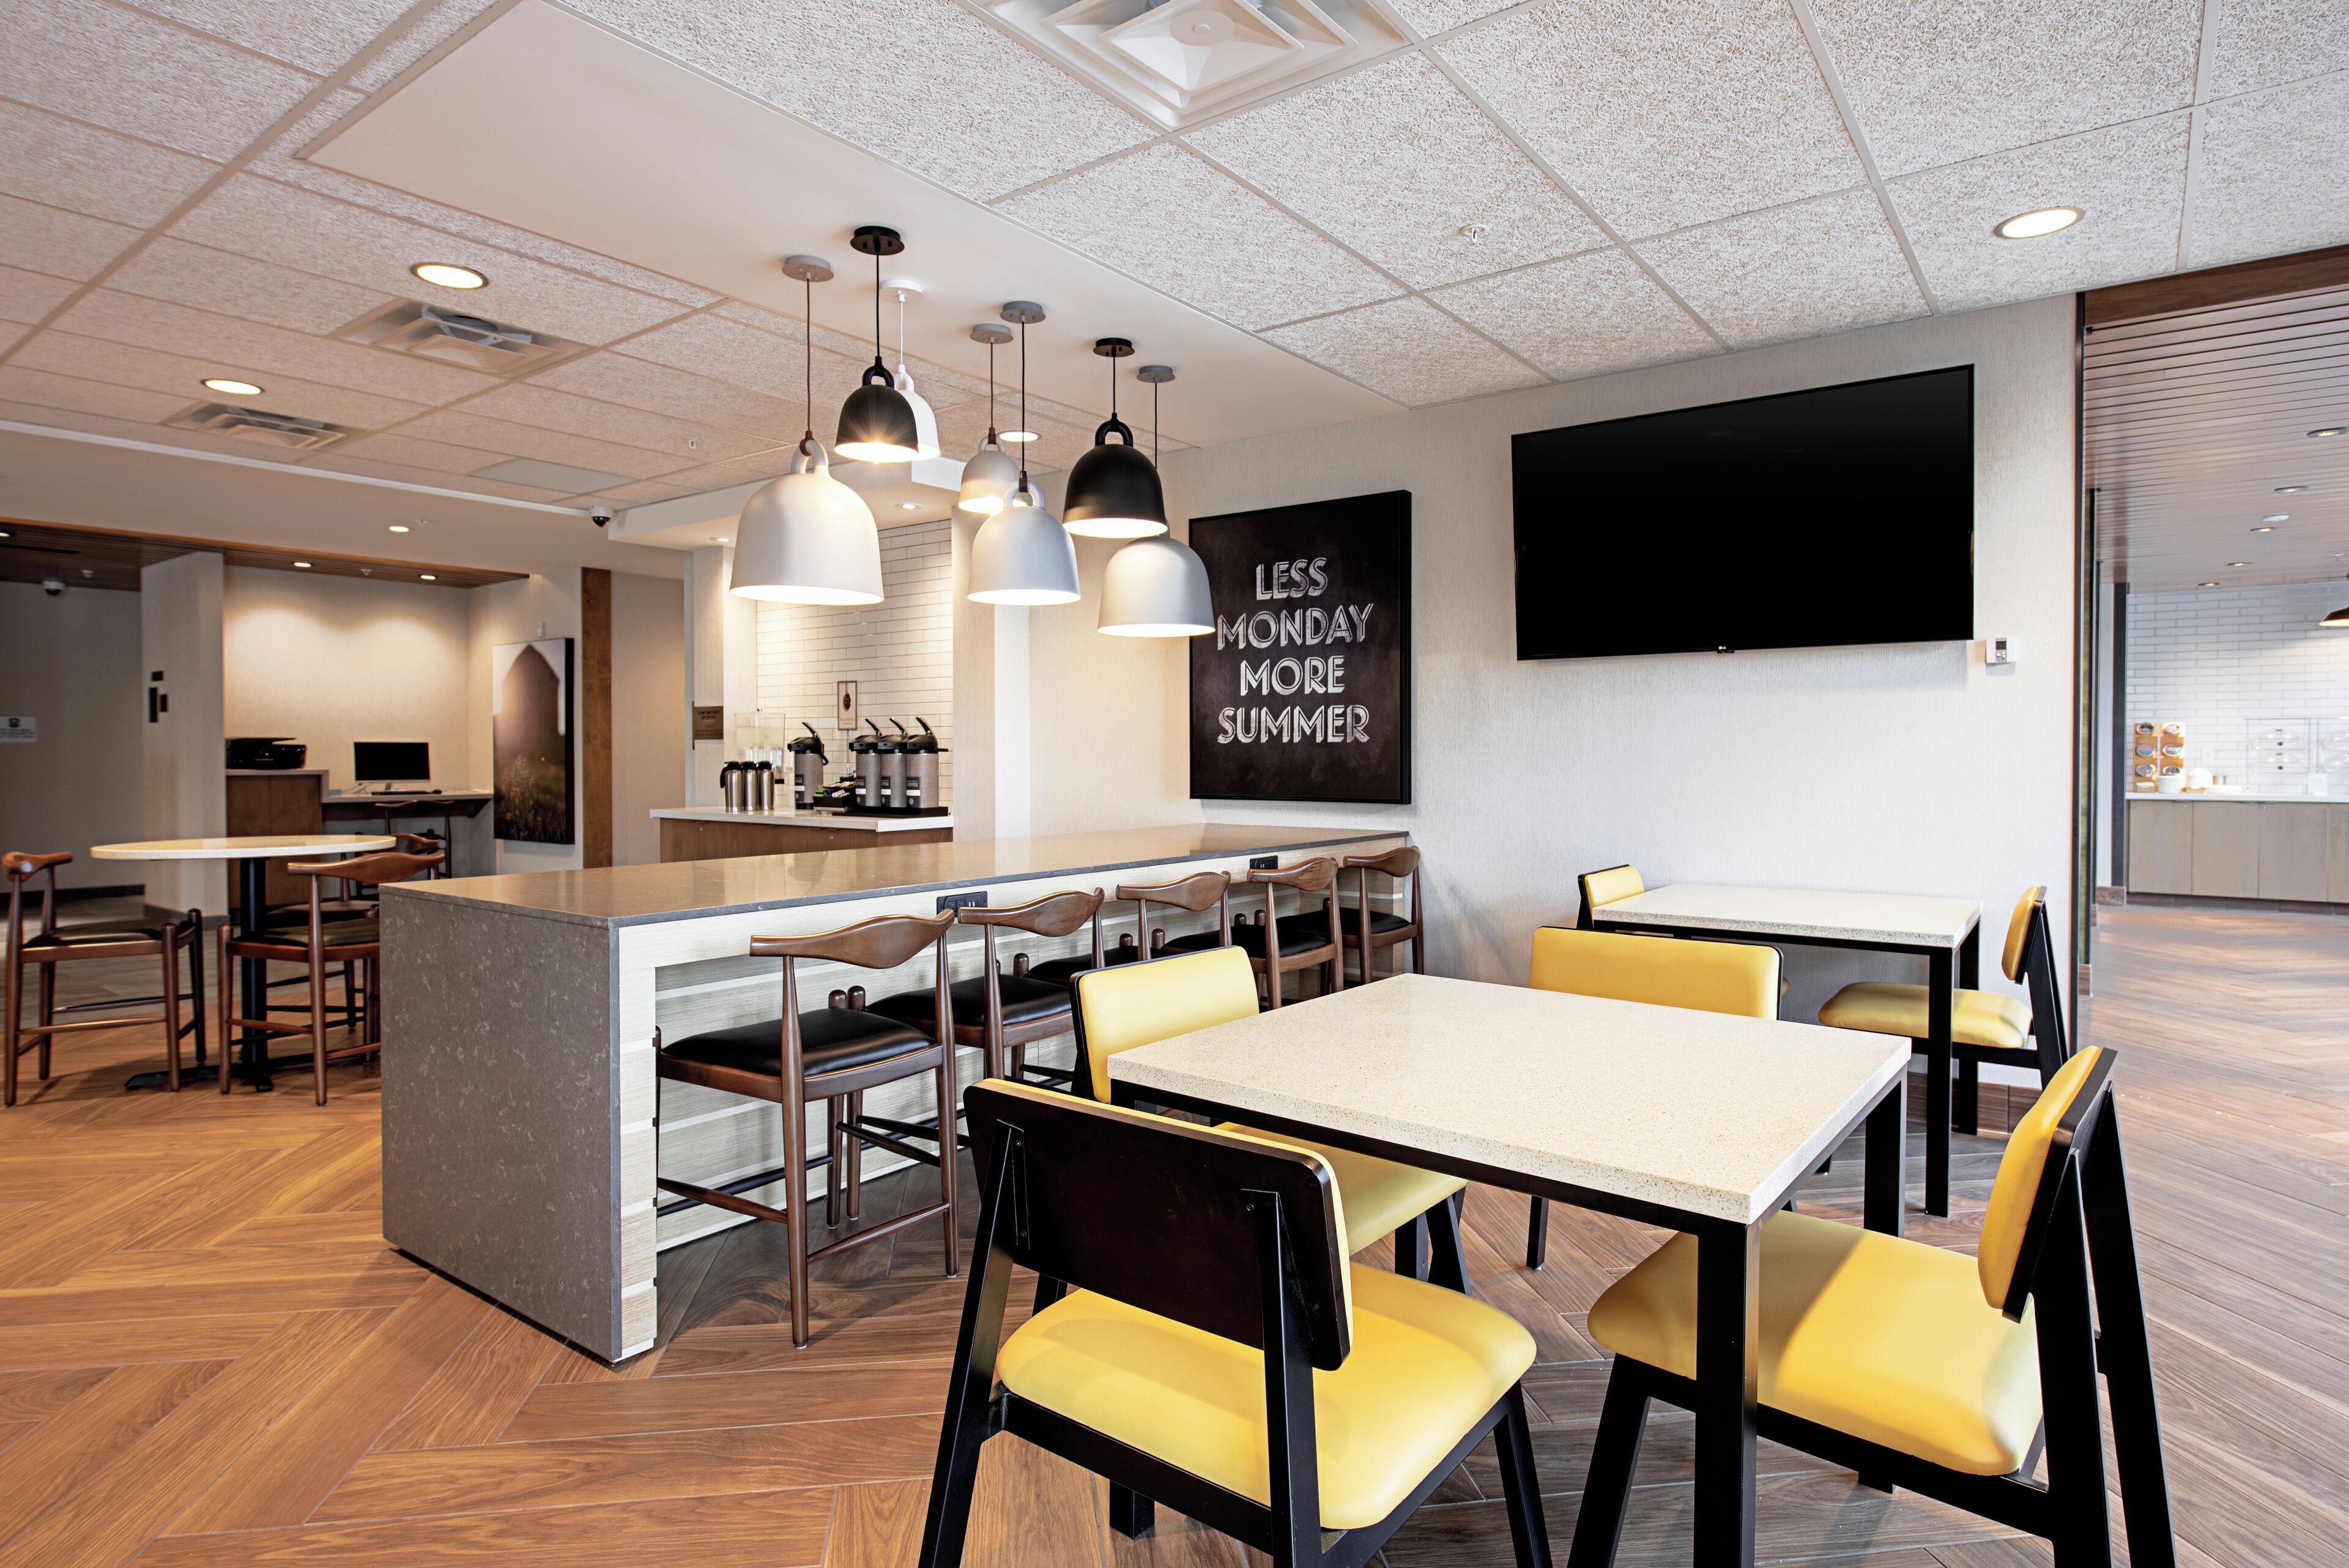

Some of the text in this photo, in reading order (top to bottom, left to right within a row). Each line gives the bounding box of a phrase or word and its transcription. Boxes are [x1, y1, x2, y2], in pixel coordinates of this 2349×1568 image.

[1256, 557, 1328, 600] LESS
[1217, 603, 1374, 650] MONDAY
[1240, 655, 1345, 696] MORE
[1217, 704, 1370, 743] SUMMER
